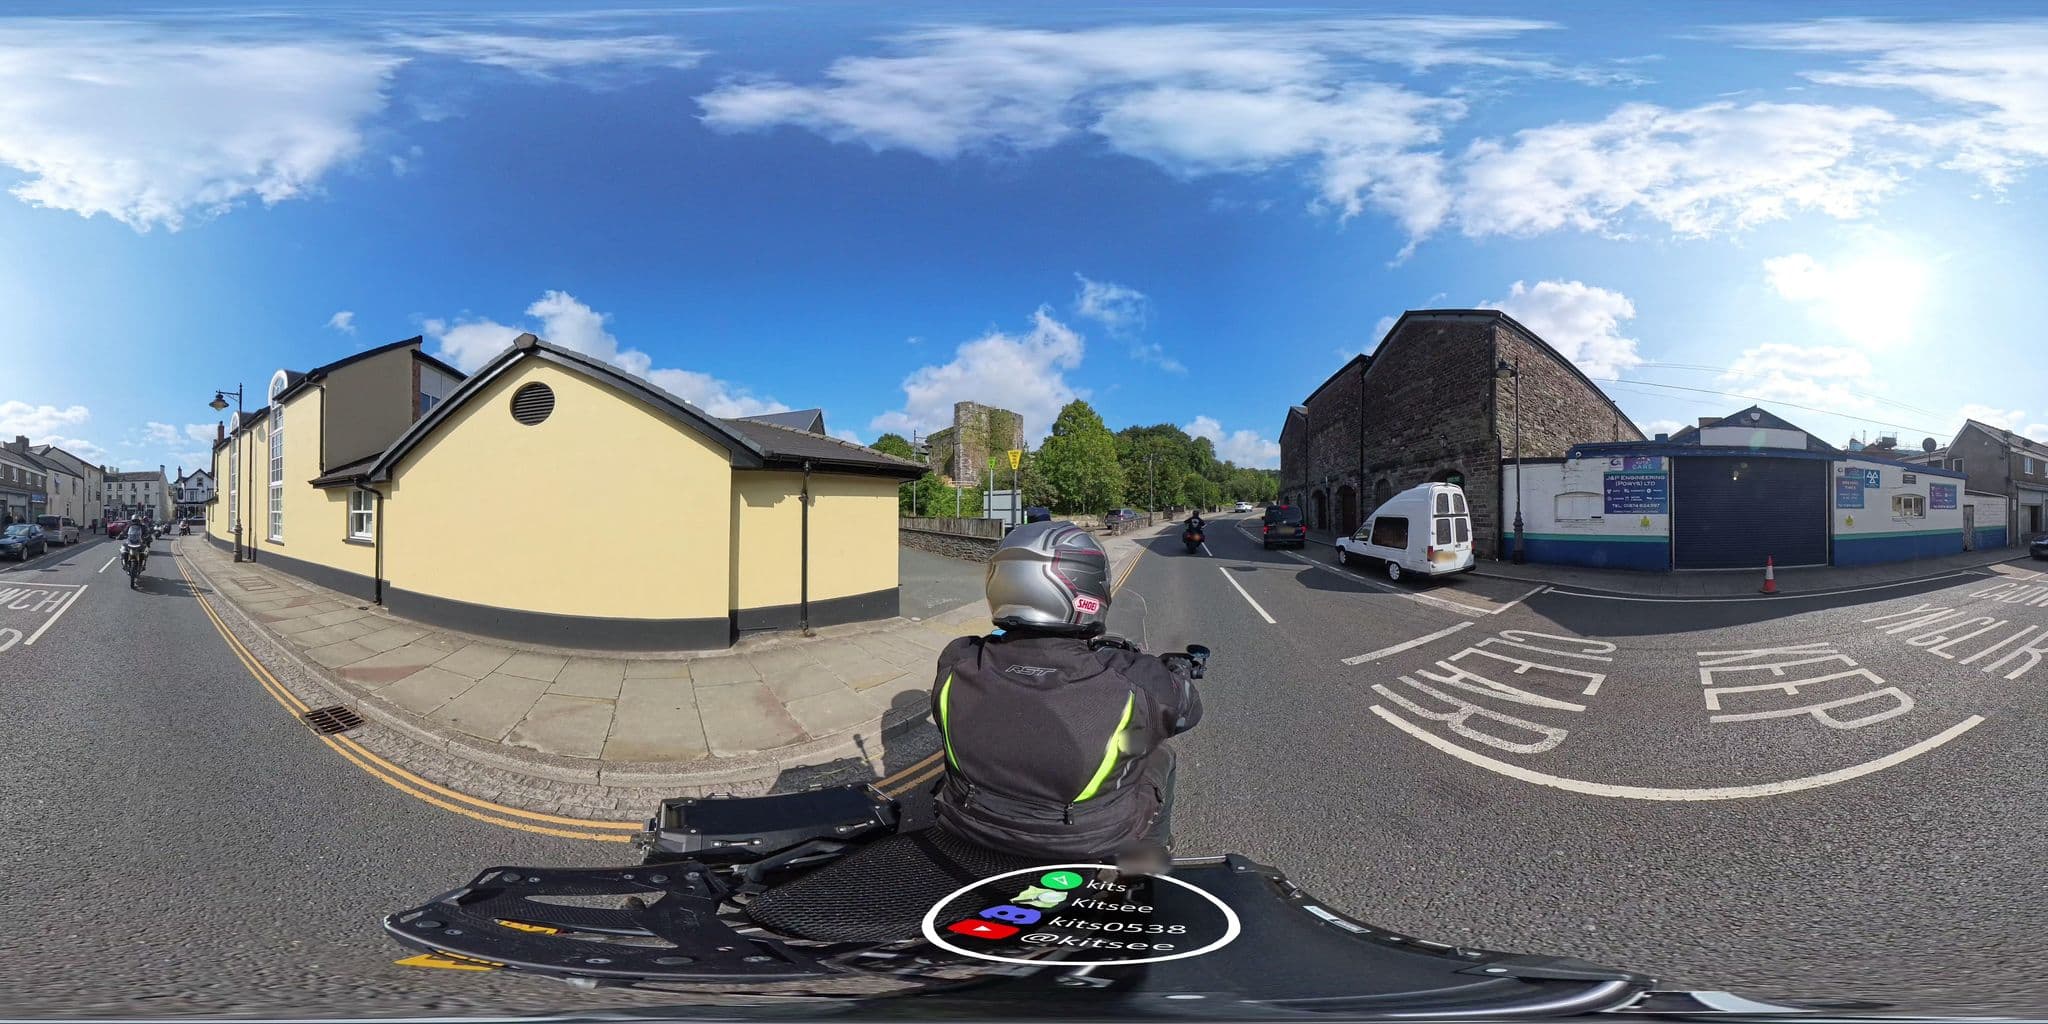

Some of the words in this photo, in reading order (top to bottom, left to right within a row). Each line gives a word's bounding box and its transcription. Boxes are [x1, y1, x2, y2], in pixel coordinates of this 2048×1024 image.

[1077, 599, 1097, 611] SHOEI
[1005, 664, 1057, 676] RST
[1371, 630, 1617, 754] CLEAR
[1697, 642, 1914, 729] KEEP
